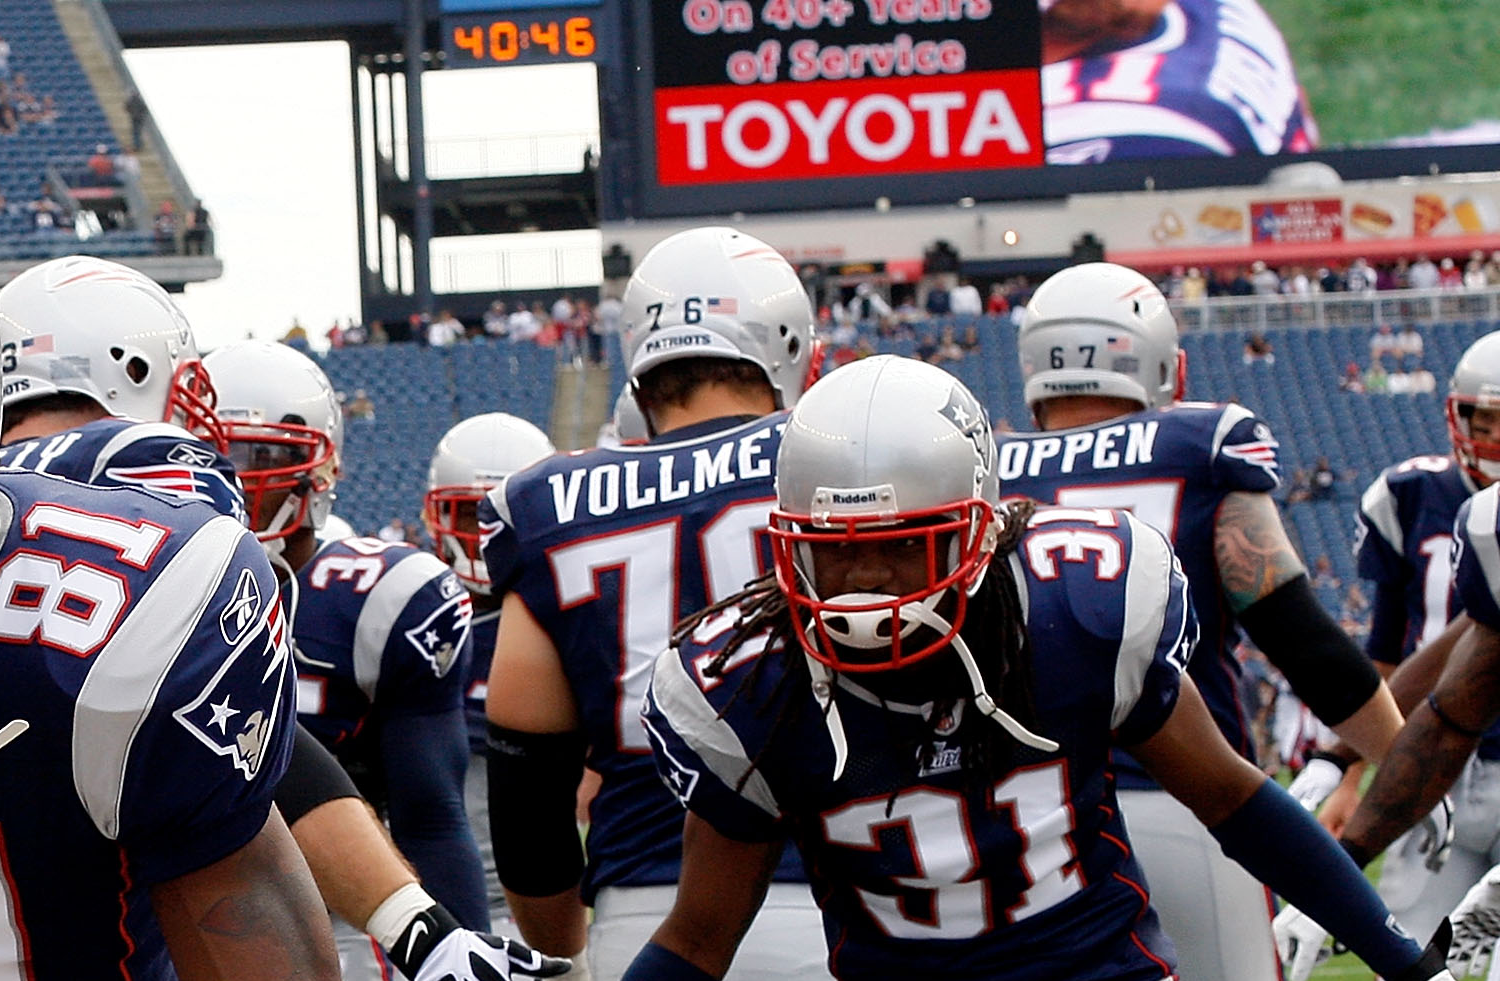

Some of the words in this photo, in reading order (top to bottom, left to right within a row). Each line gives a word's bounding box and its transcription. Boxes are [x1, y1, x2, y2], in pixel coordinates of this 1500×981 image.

[454, 17, 596, 61] 40:46
[683, 0, 752, 33] On
[726, 40, 781, 84] of
[789, 34, 966, 81] Service
[667, 89, 1031, 170] TOYOTA
[647, 334, 712, 352] PATRIOTS
[548, 424, 785, 524] VOLLME
[833, 493, 876, 504] Riddell
[820, 757, 1088, 940] 31
